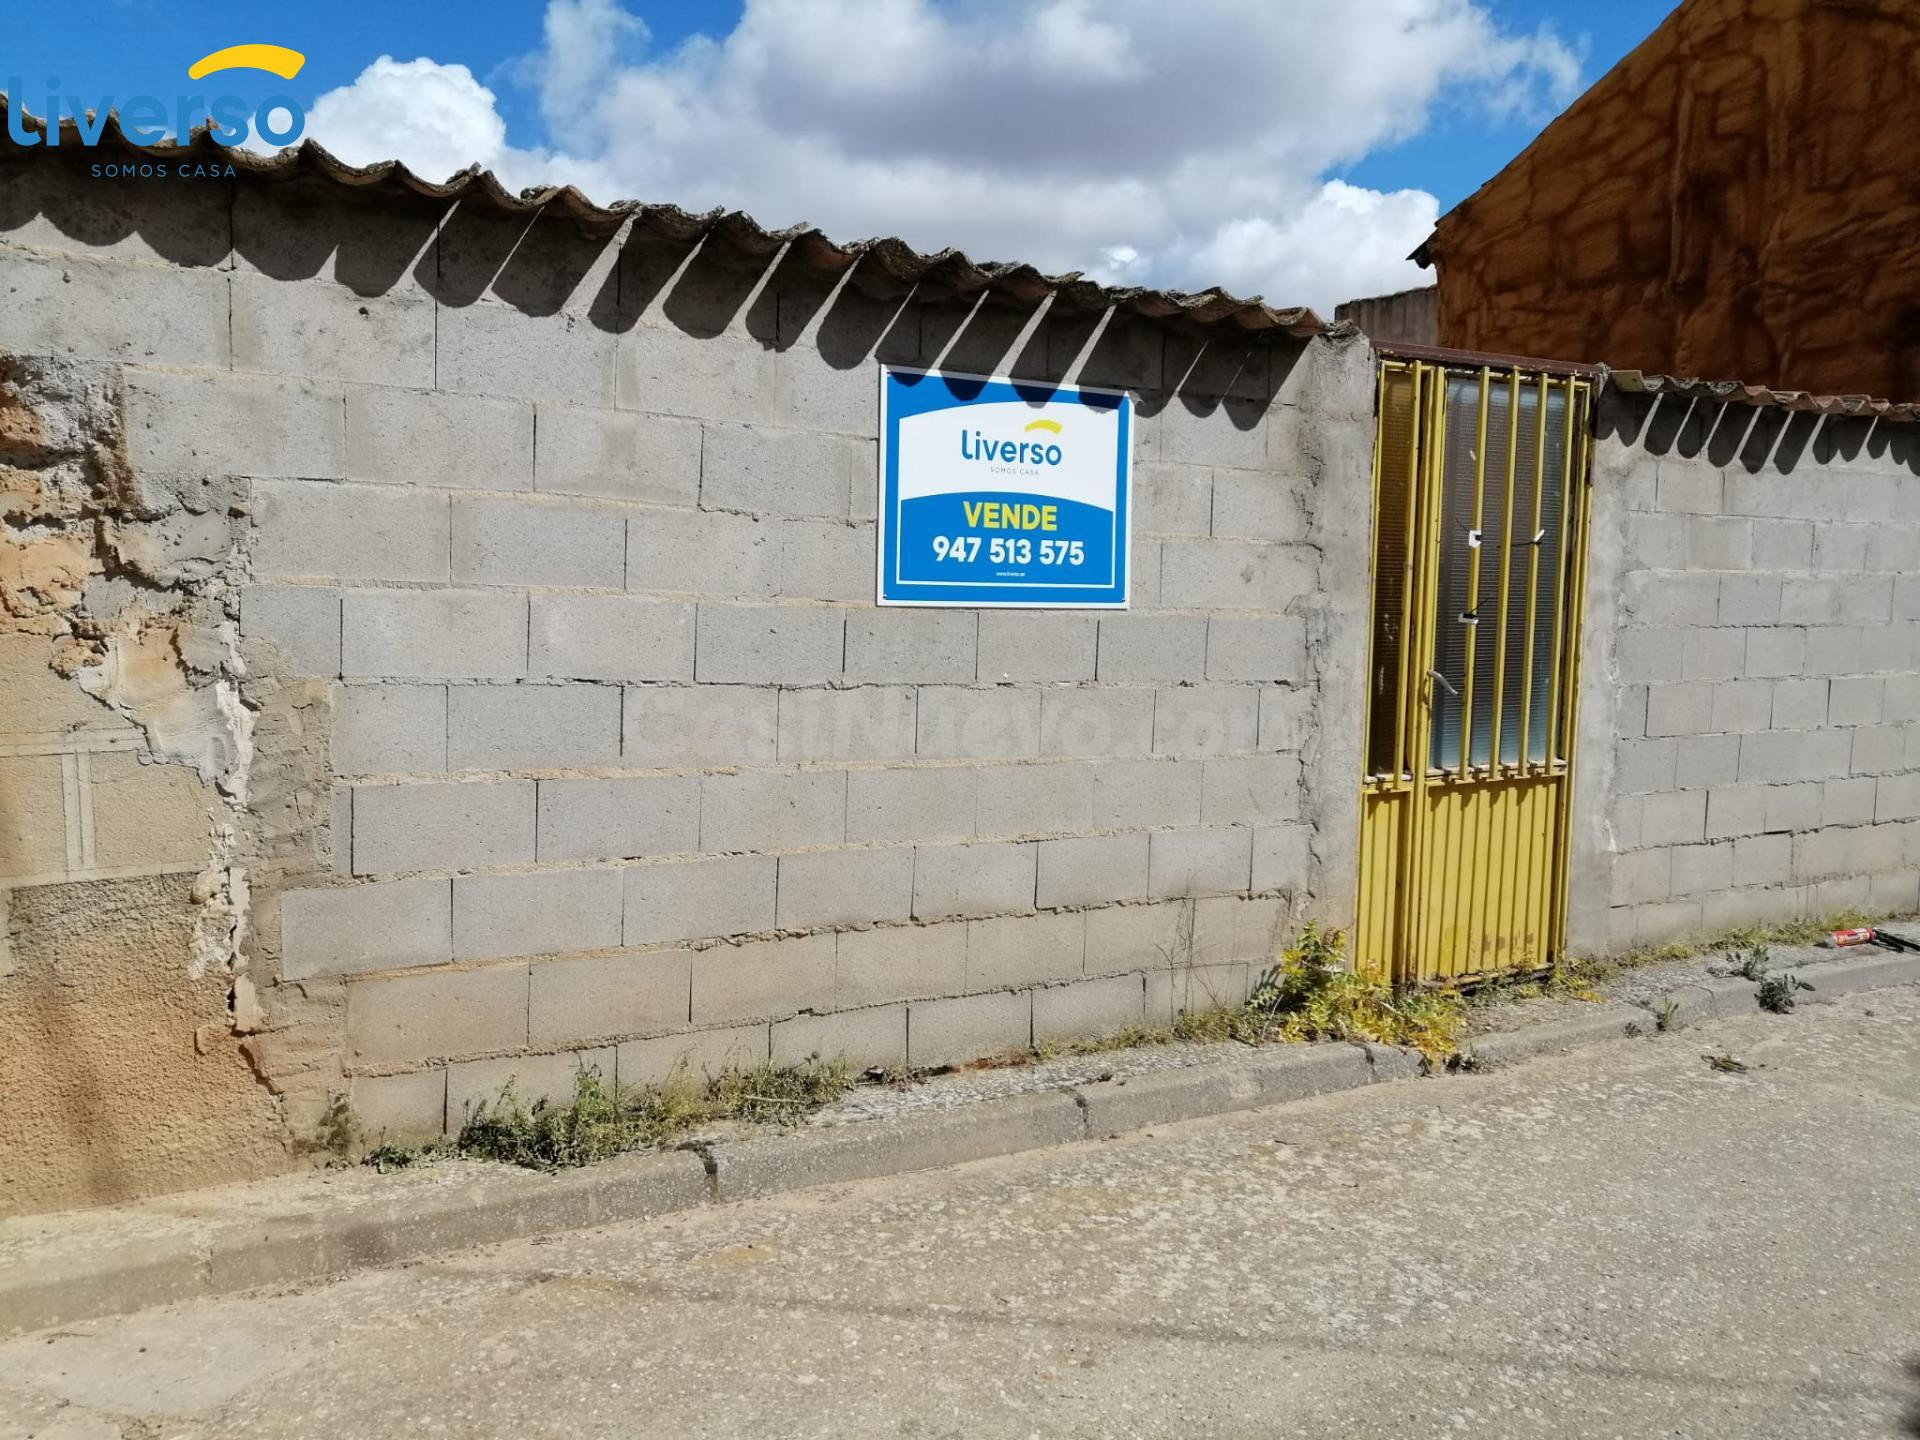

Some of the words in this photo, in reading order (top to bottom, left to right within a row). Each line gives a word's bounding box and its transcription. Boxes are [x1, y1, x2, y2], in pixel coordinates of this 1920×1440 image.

[990, 466, 1016, 475] SOMOS
[1019, 468, 1039, 476] CASA
[963, 501, 1058, 531] VENDE
[932, 535, 982, 563] 947
[989, 538, 1031, 564] 513
[1039, 540, 1085, 565] 575
